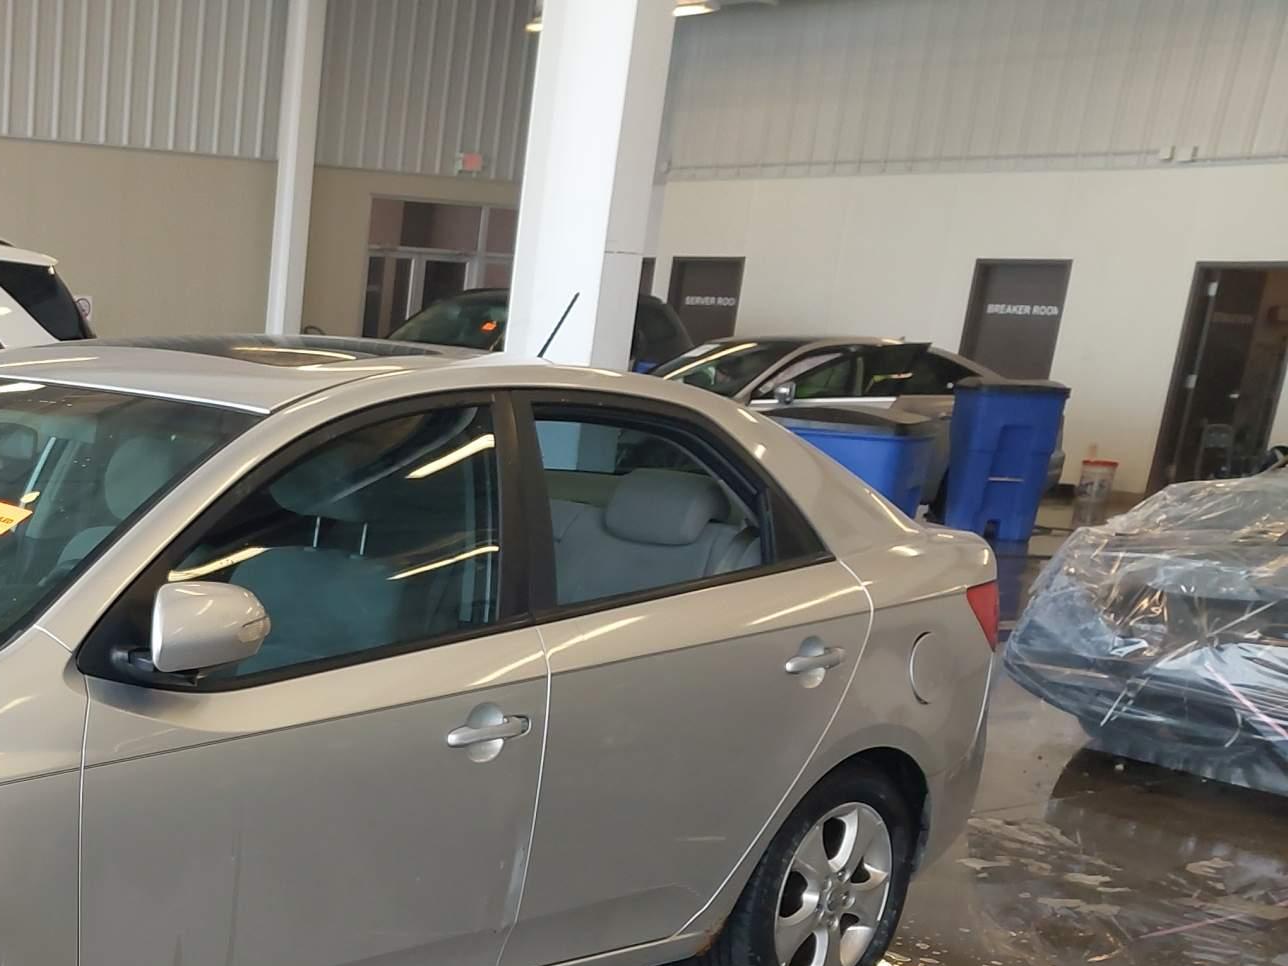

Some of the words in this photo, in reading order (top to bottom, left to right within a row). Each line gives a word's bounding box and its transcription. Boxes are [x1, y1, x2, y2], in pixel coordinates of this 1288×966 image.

[685, 295, 715, 306] SERVER
[717, 296, 737, 306] ROO
[987, 303, 1031, 315] BREAKER
